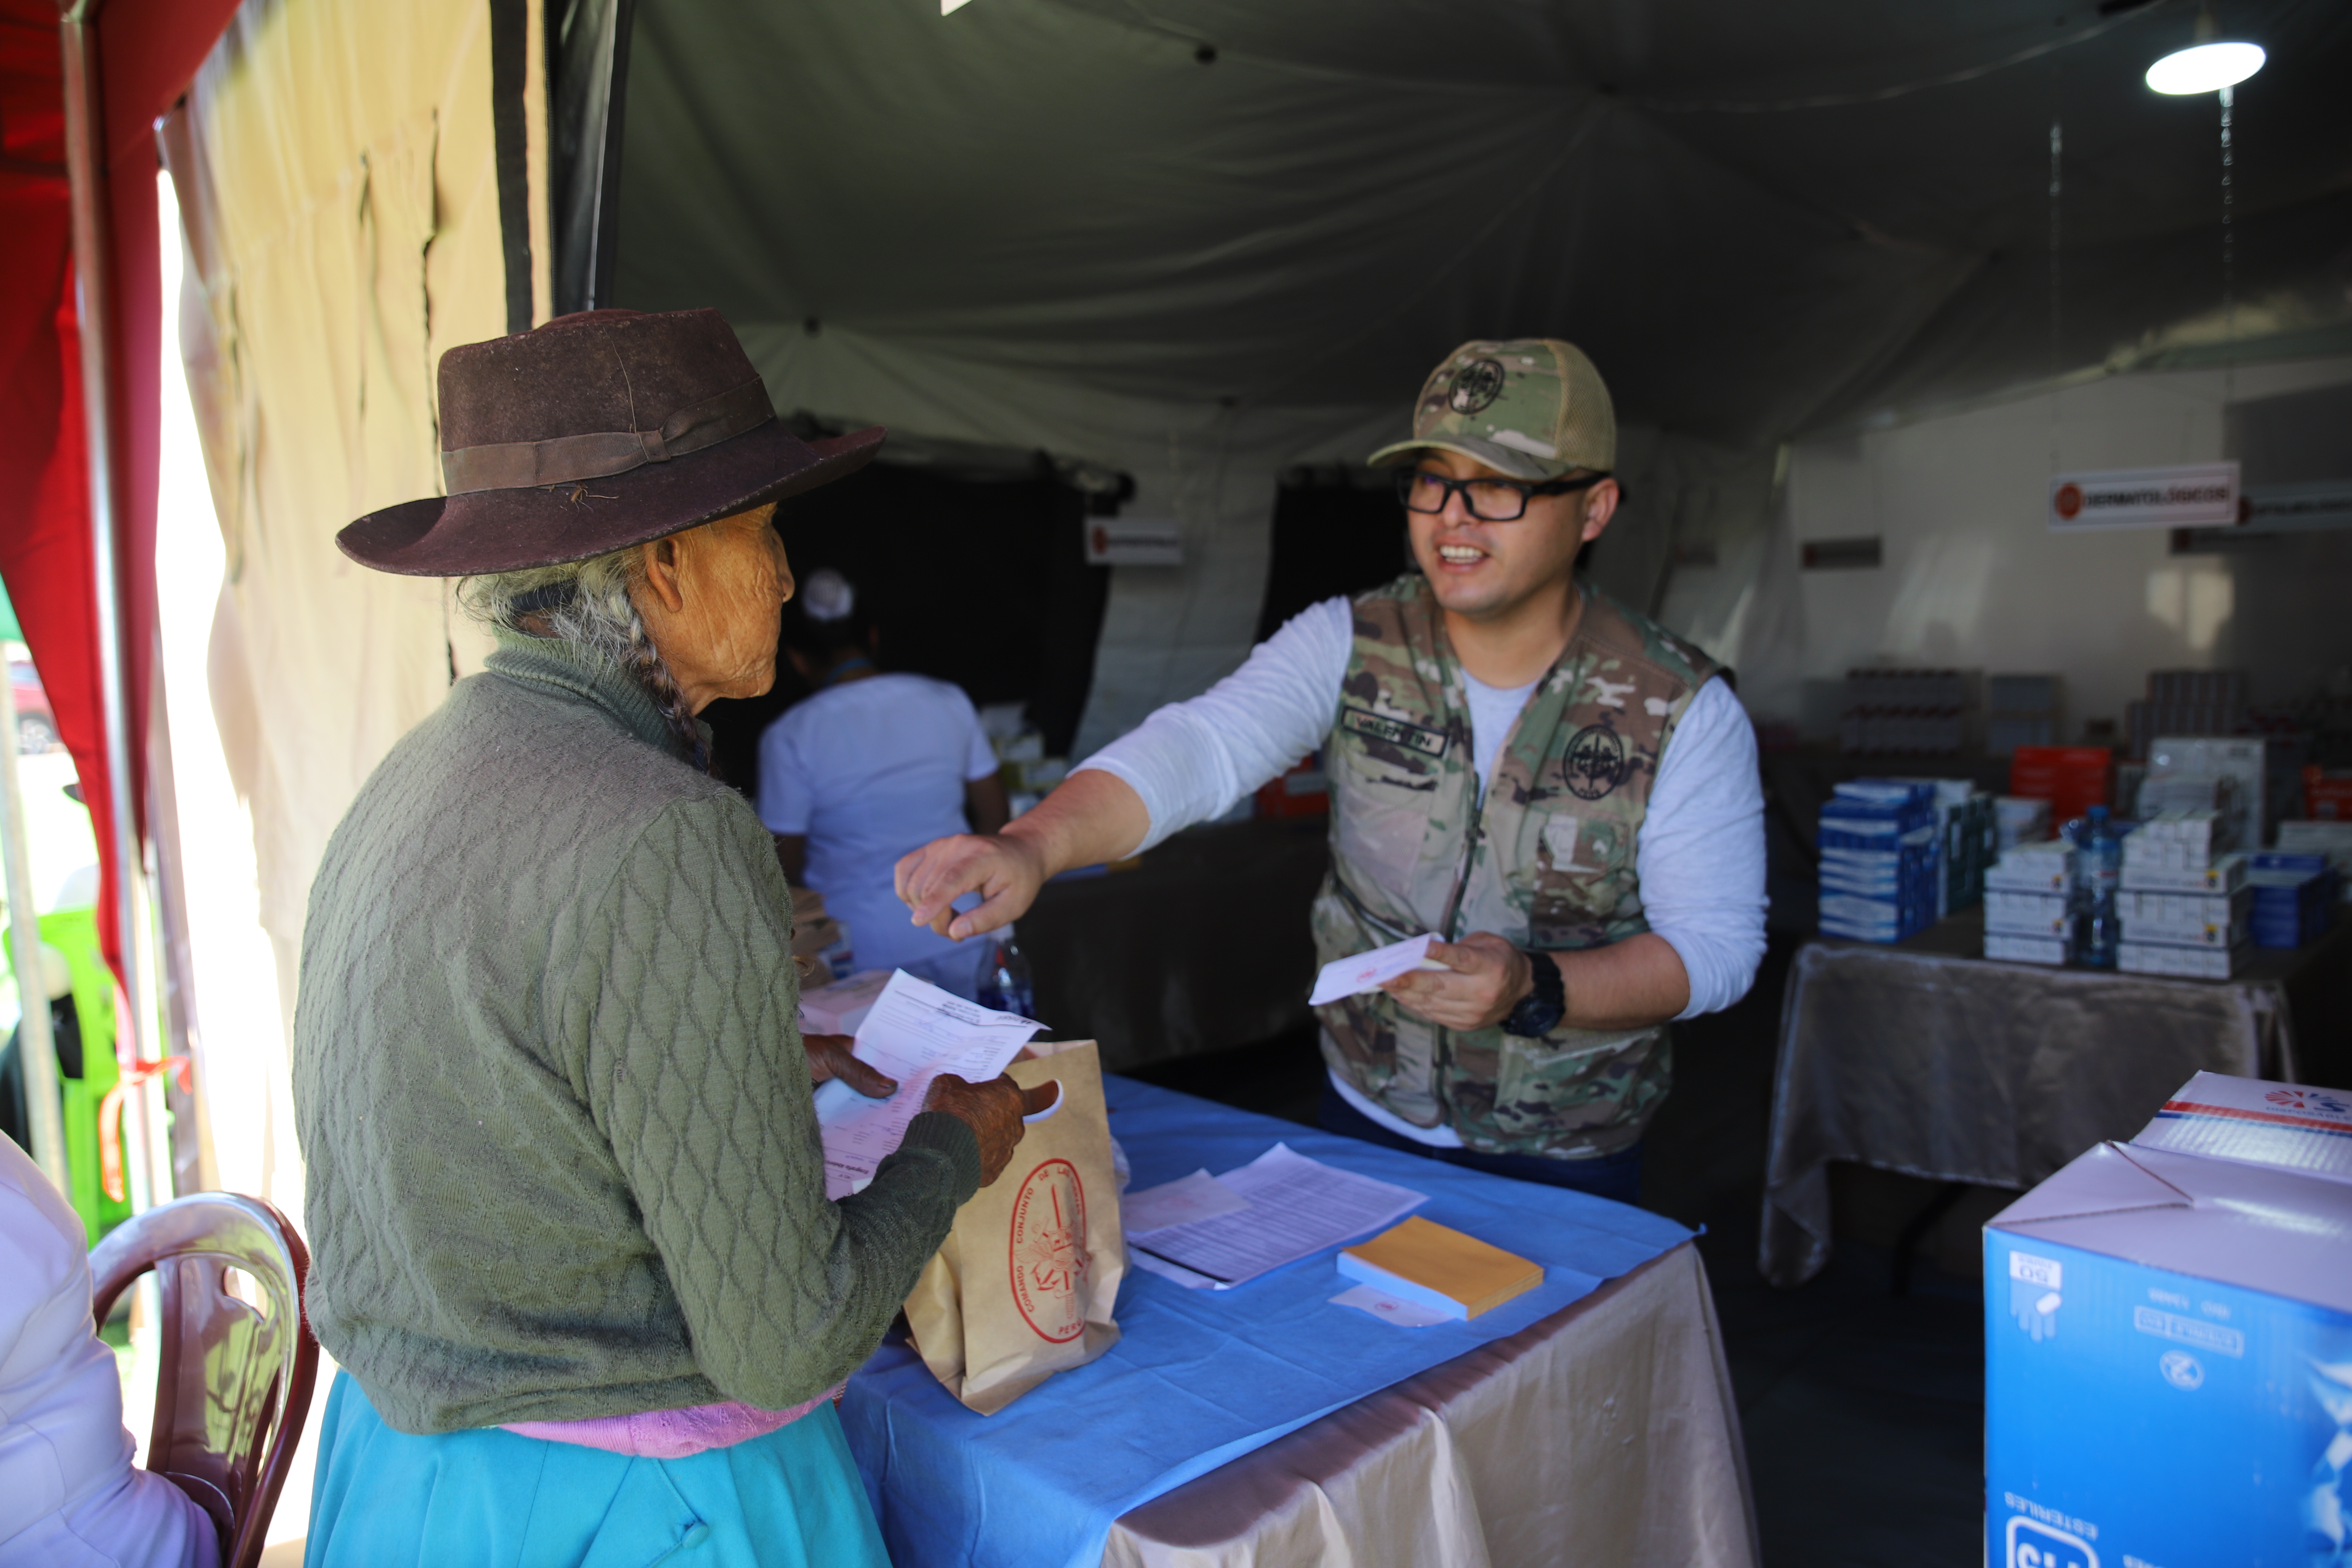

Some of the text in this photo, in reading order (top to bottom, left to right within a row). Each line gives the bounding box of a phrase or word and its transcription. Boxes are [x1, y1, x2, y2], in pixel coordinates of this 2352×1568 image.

[1038, 1169, 1049, 1181] DE
[1016, 1187, 1034, 1244] CONJUNTO
[1016, 1265, 1035, 1312] COMANDO
[2019, 1266, 2049, 1285] 50
[2004, 1491, 2098, 1542] ESTERILES
